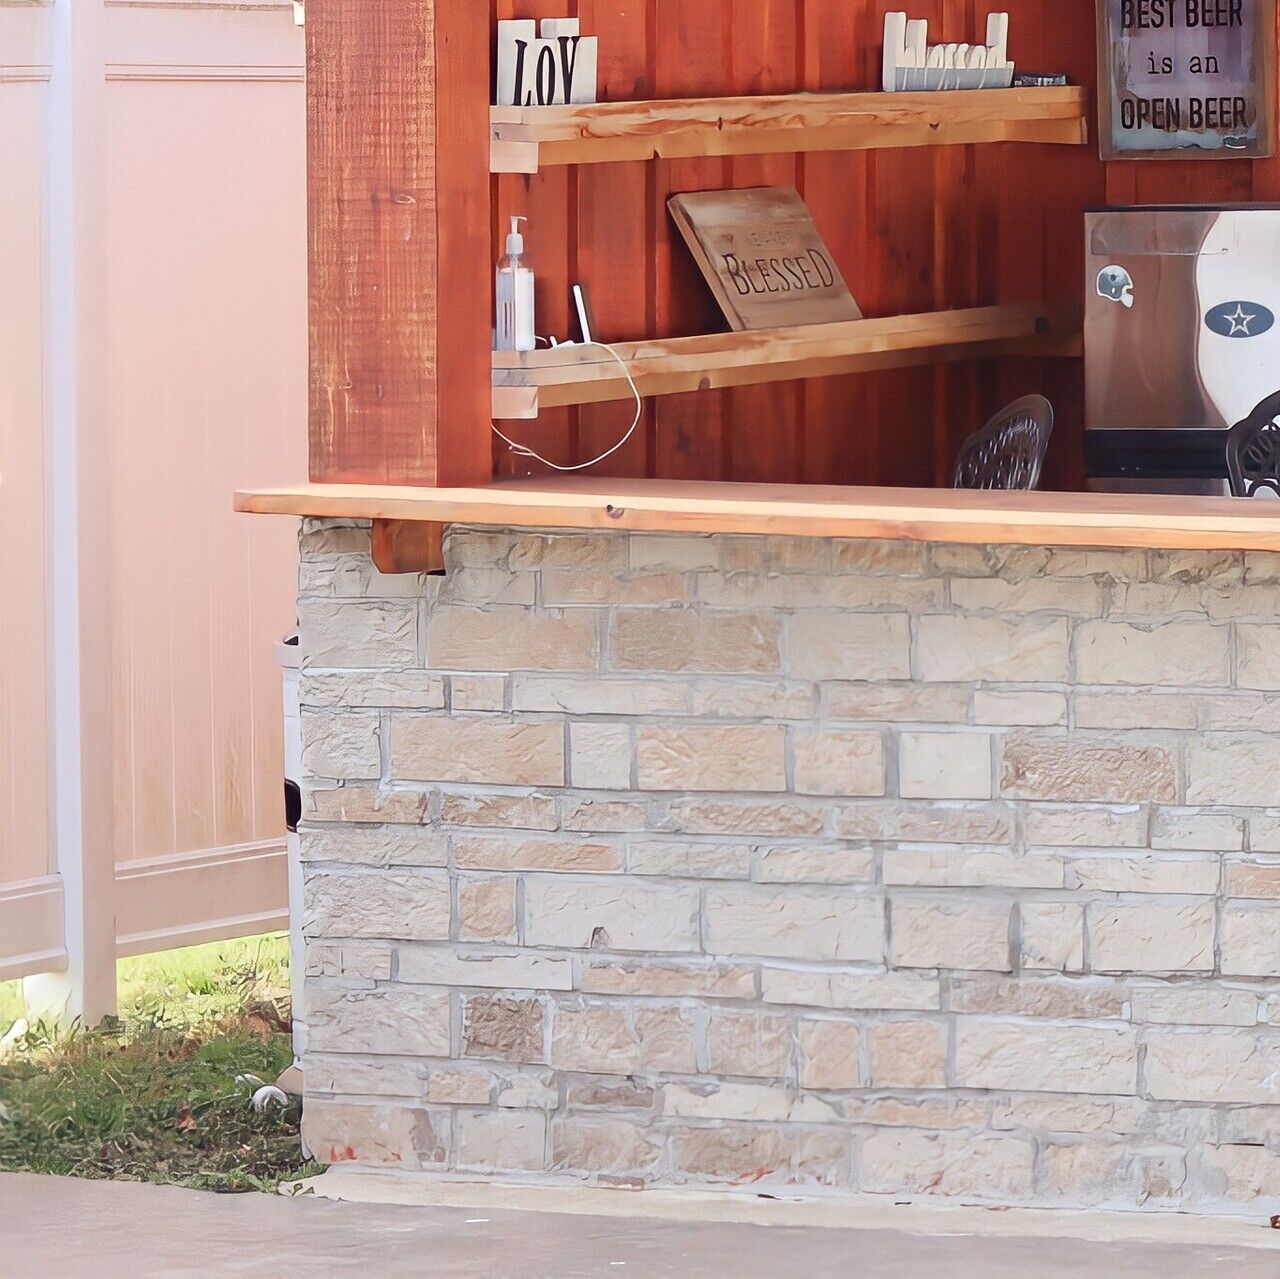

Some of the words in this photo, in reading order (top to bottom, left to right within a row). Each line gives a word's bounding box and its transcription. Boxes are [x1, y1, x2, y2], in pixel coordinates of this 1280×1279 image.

[1148, 51, 1173, 75] is
[1189, 55, 1219, 74] an
[1120, 97, 1181, 130] OPEN
[1189, 96, 1249, 129] BEER
[721, 248, 834, 296] BLESSED
